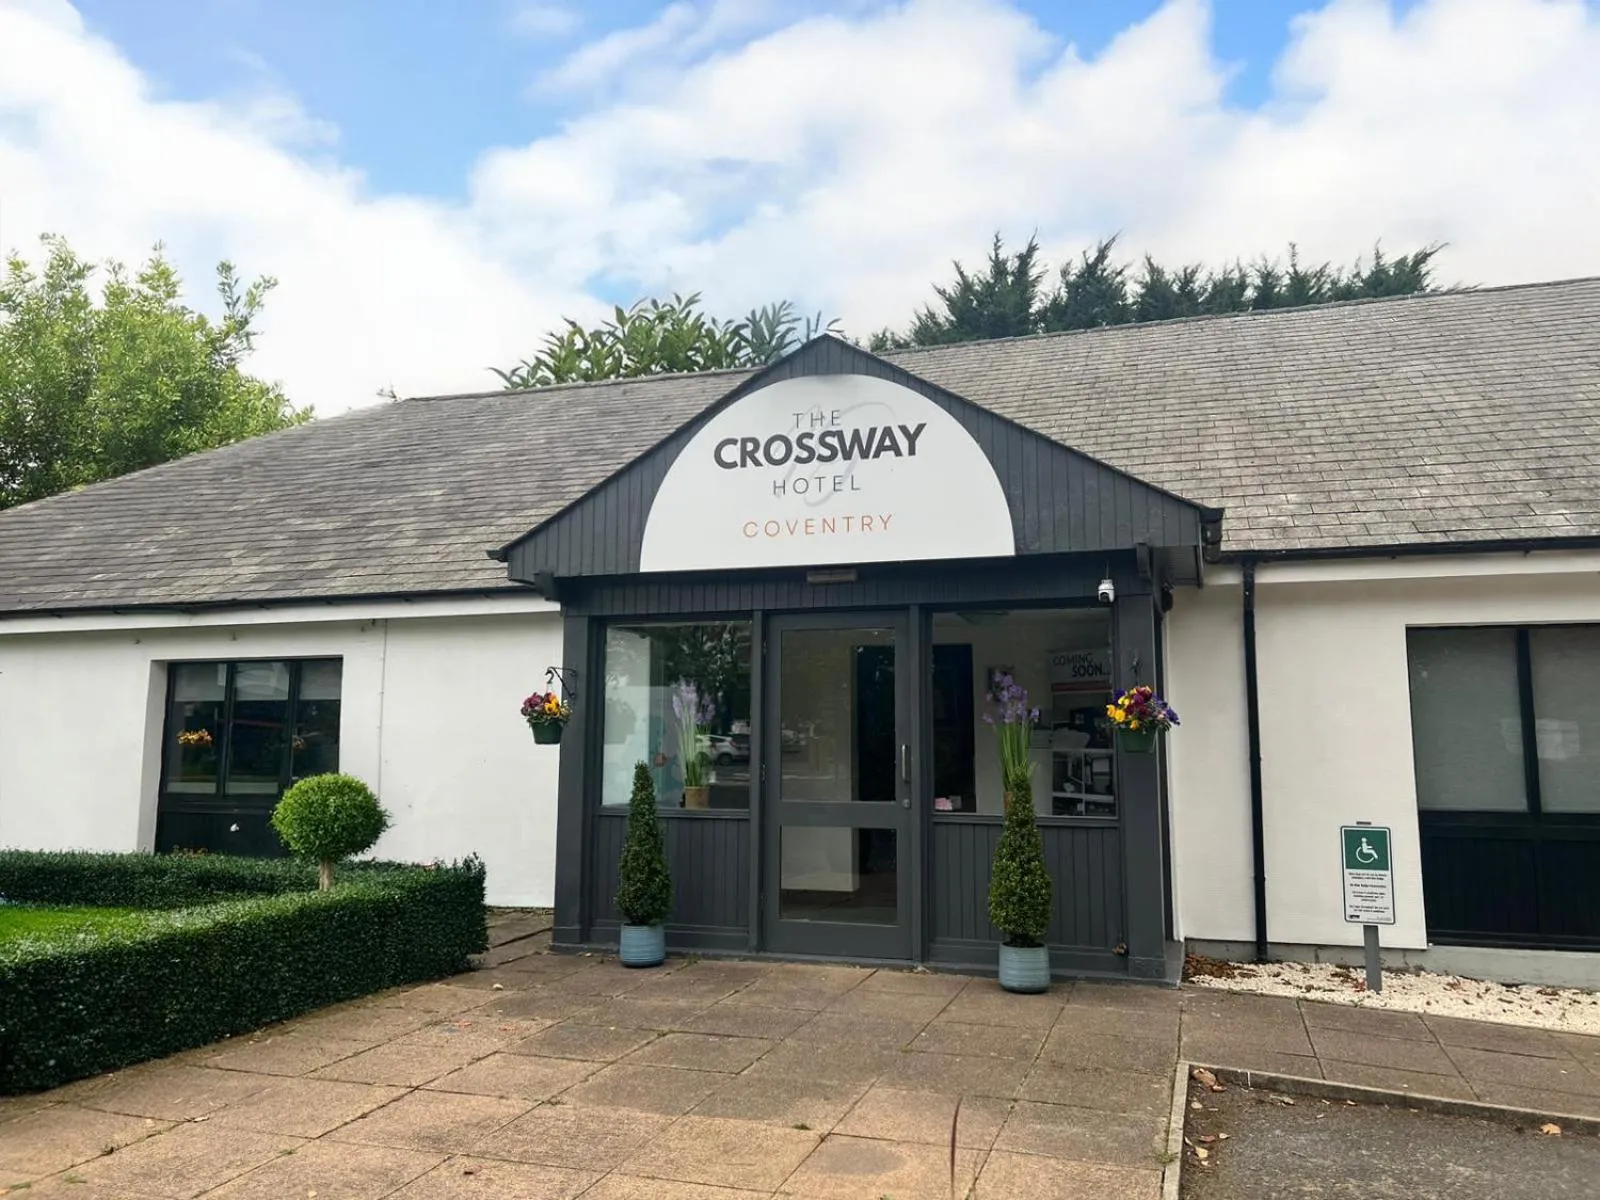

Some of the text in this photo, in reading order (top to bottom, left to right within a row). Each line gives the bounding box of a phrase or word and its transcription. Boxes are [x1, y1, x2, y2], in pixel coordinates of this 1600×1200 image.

[793, 410, 841, 428] THE
[713, 423, 927, 469] CROSSWAY
[773, 474, 861, 496] HOTEL
[743, 514, 893, 538] COVENTRY
[1053, 652, 1093, 666] COMING
